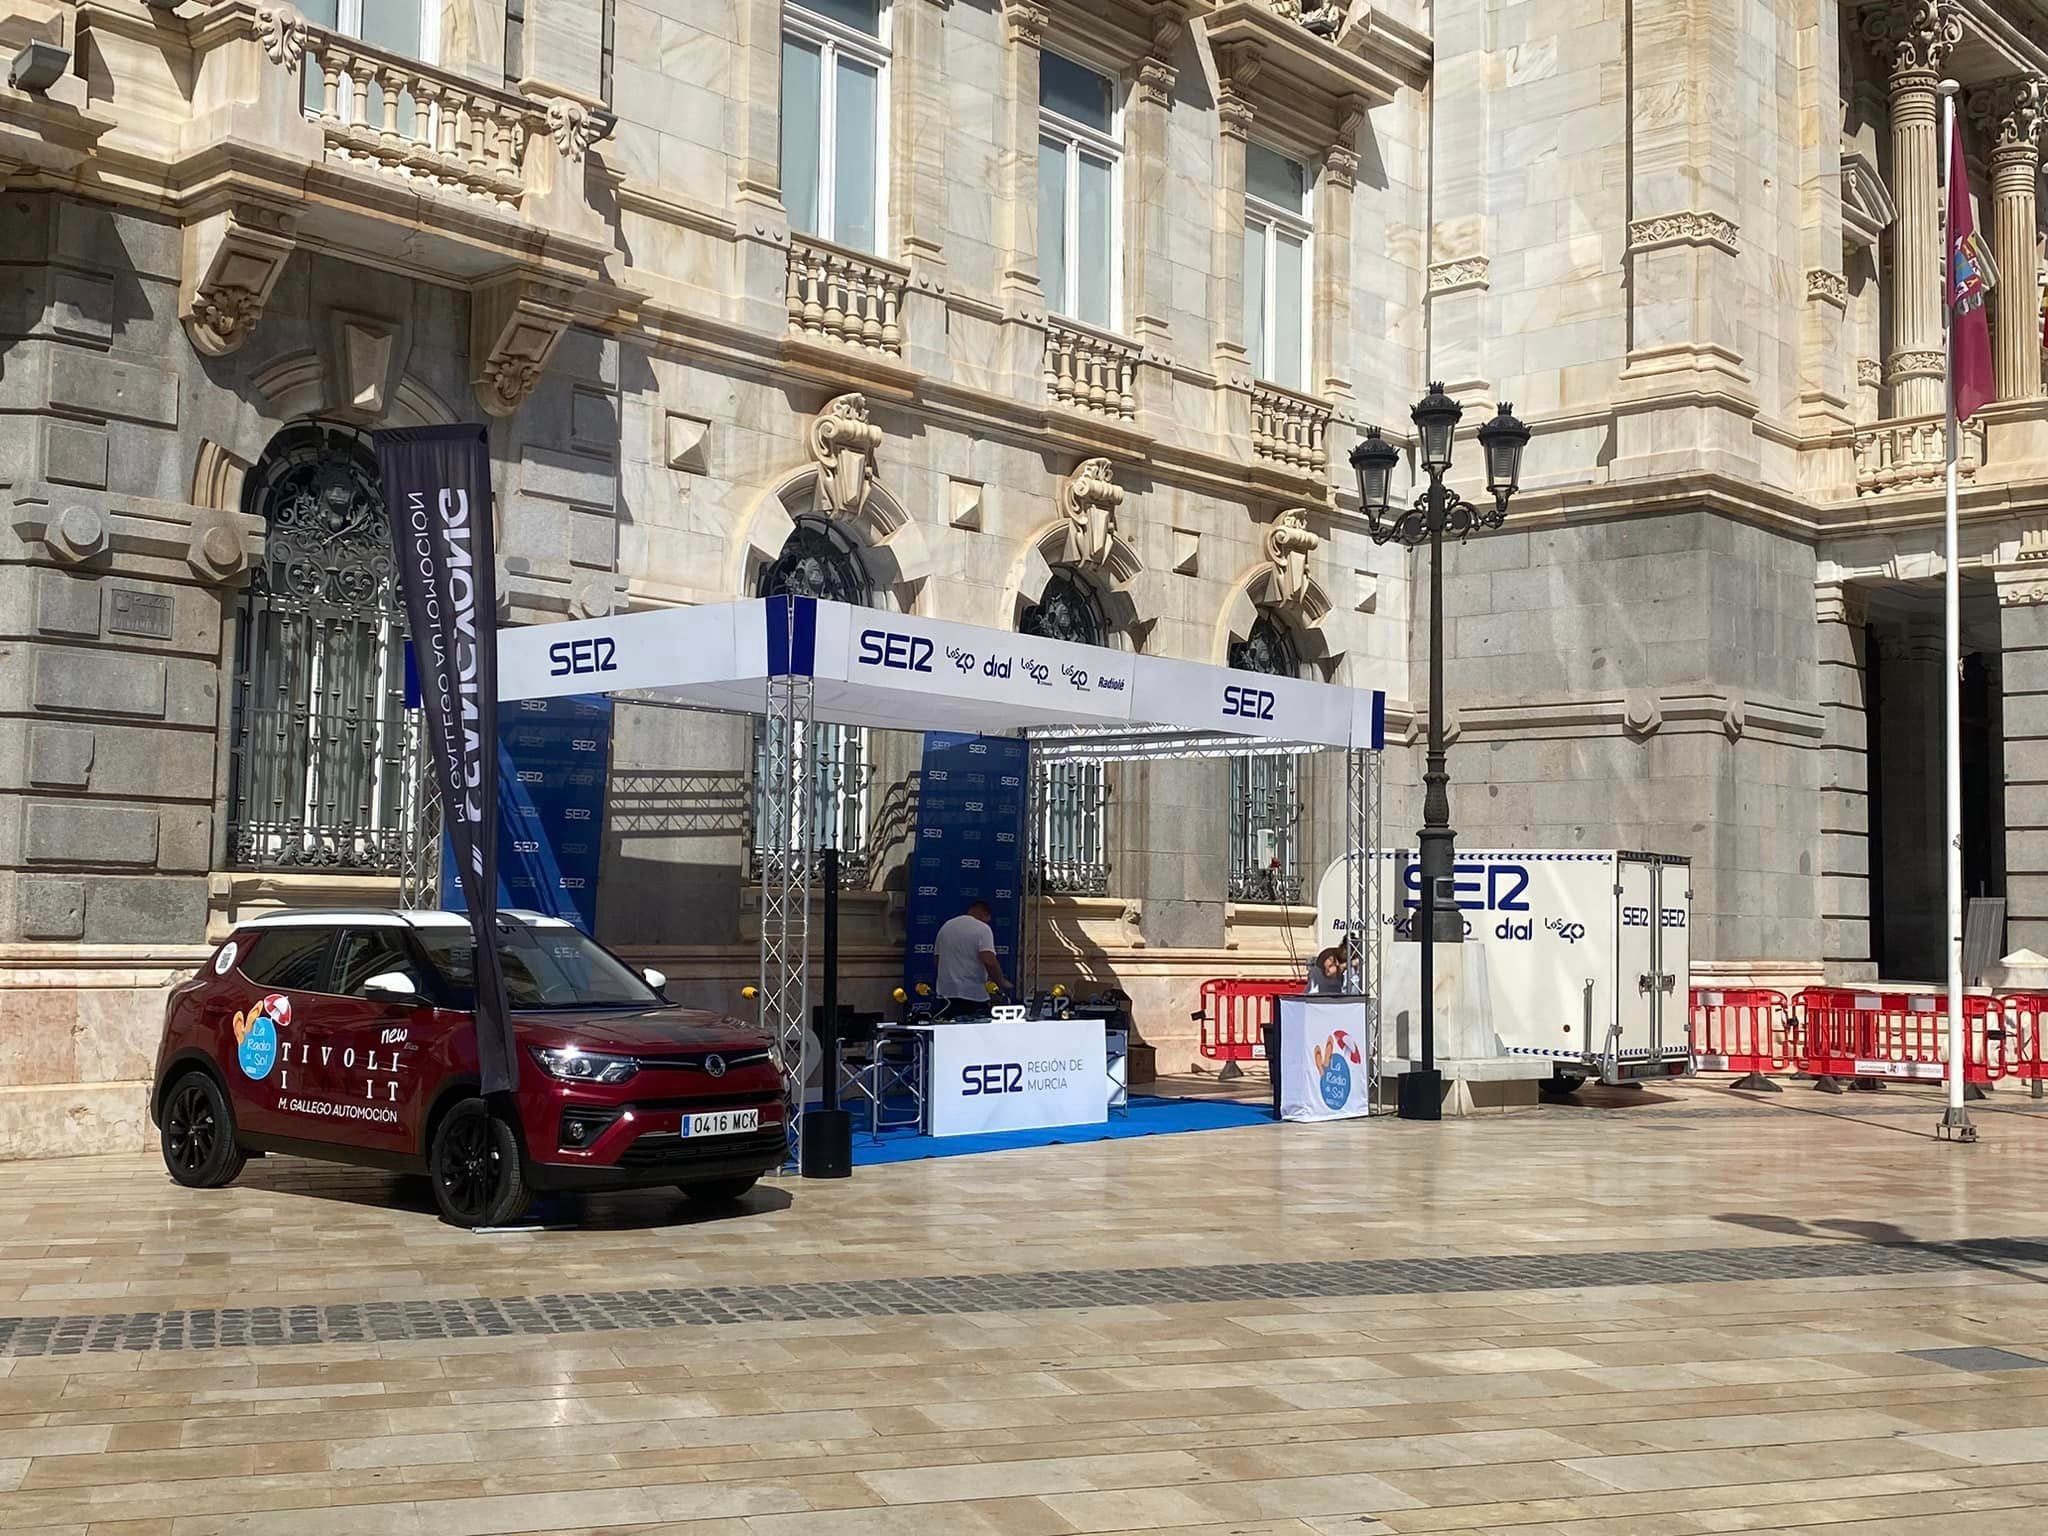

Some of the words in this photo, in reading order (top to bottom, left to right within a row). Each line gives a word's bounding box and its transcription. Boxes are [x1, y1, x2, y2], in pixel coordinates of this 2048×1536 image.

[549, 637, 617, 676] SER
[858, 629, 935, 673] SER
[983, 654, 1012, 679] dial
[520, 700, 548, 712] SER
[1222, 685, 1276, 721] SER
[572, 740, 596, 751] SER
[968, 744, 987, 754] SER
[516, 771, 544, 782] SER
[928, 770, 948, 781] SER
[1001, 776, 1020, 786] SER
[964, 802, 984, 812] SER
[564, 808, 591, 820] SER
[923, 828, 942, 838] SER
[996, 832, 1015, 843] SER
[513, 841, 540, 852] SER
[961, 858, 980, 869] SER
[559, 878, 584, 888] SER
[918, 886, 938, 896] SER
[996, 888, 1012, 898] SER
[1622, 906, 1649, 926] SER
[1661, 909, 1686, 928] SER
[1496, 917, 1533, 940] dial
[914, 944, 935, 953] SER
[991, 1005, 1026, 1020] SER
[381, 1028, 408, 1044] new
[254, 1053, 268, 1066] Sol
[282, 1042, 400, 1072] TIVOLI
[962, 1062, 1024, 1096] SER
[1028, 1060, 1066, 1073] REGIÓN
[1070, 1059, 1083, 1071] DE
[1028, 1078, 1068, 1090] MURCIA
[278, 1097, 288, 1110] M.
[290, 1098, 332, 1116] GALLEGO
[332, 1105, 398, 1122] AUTOMOCIÓN
[694, 1116, 728, 1133] 0416
[732, 1112, 756, 1130] MCK
